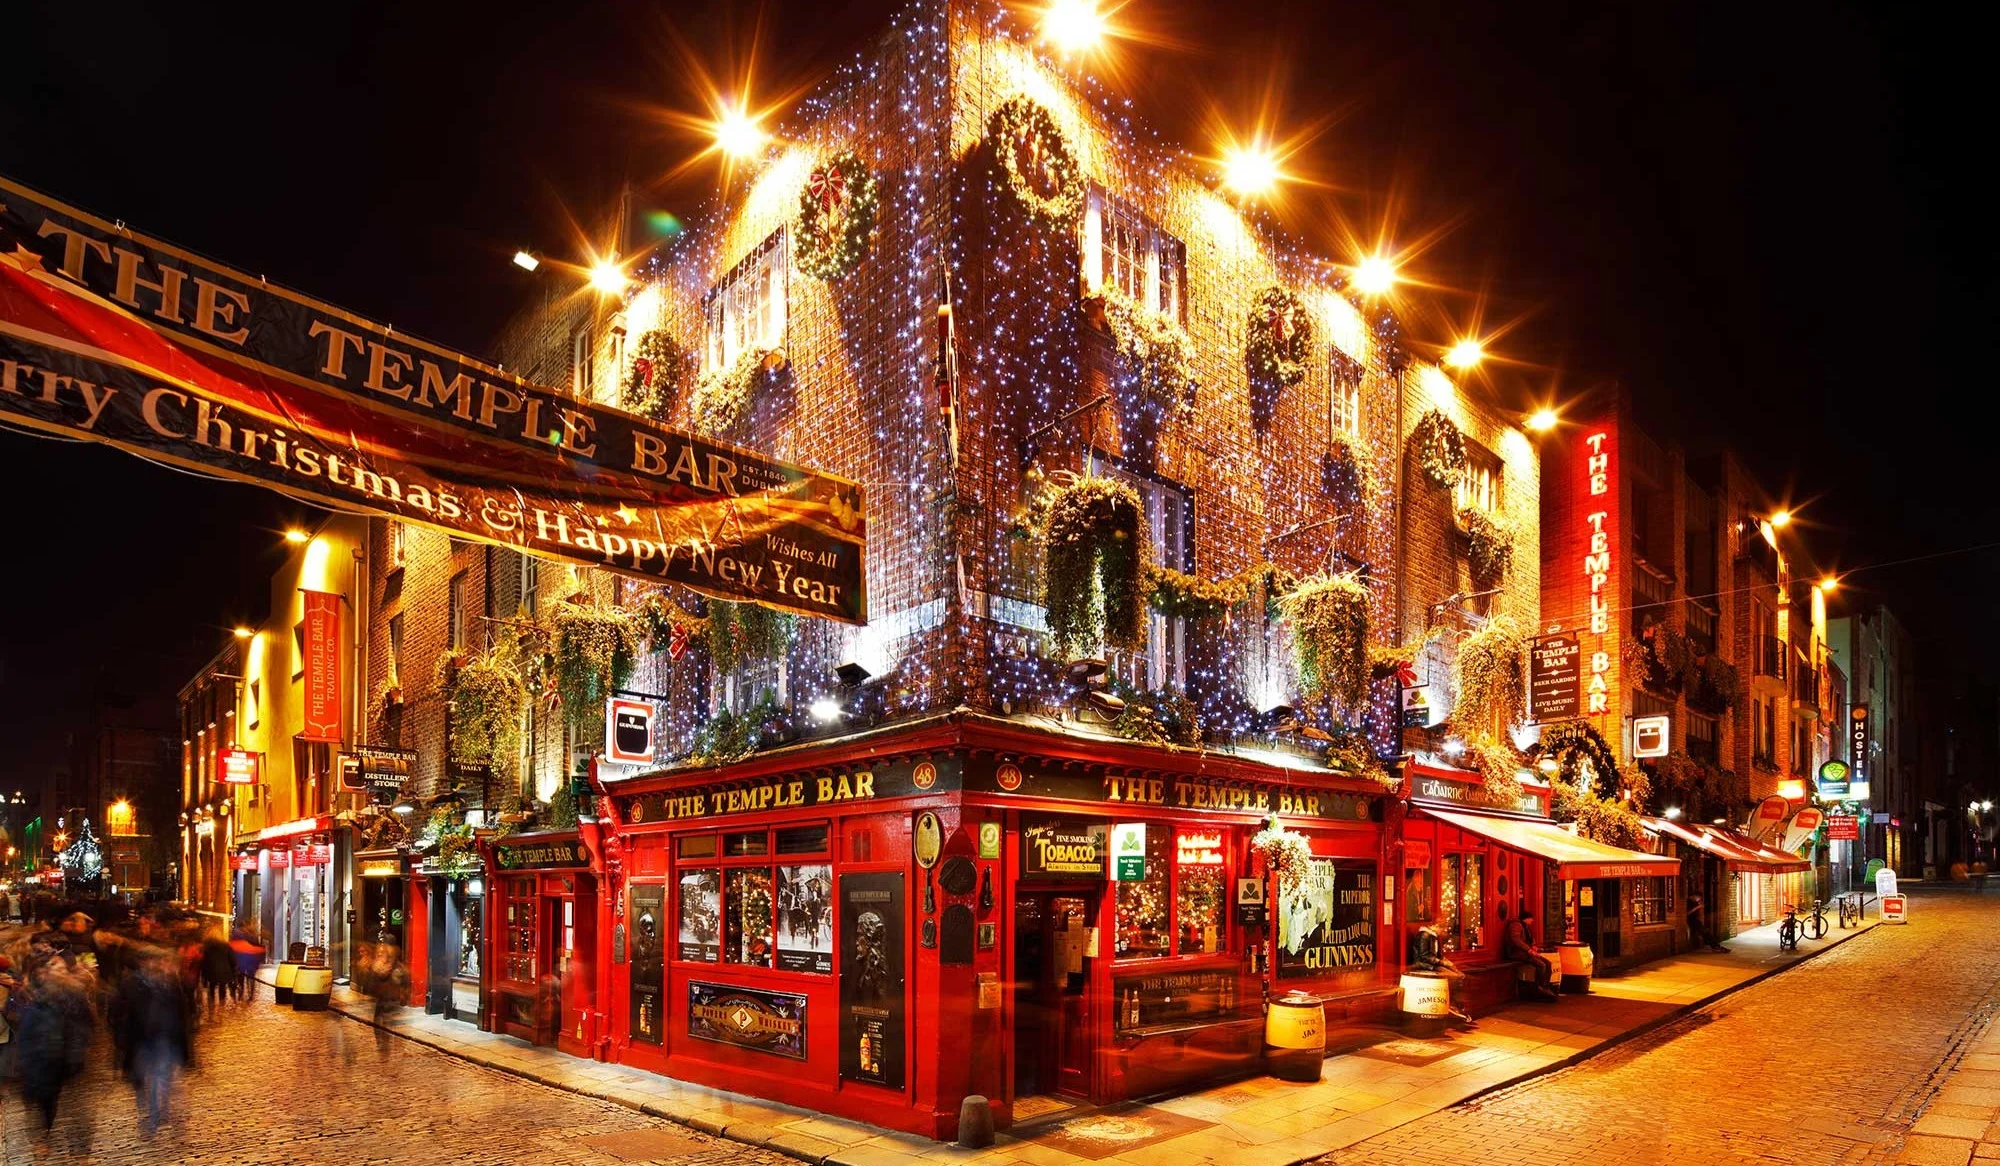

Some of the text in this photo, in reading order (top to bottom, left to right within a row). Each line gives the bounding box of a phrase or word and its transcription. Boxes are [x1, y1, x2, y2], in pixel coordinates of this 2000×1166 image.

[37, 218, 740, 498] THE TEMPLE BAR
[742, 475, 790, 493] DUBLIN
[141, 387, 463, 519] Christmas
[481, 497, 521, 532] &
[531, 507, 679, 576] Happy
[679, 537, 763, 588] New
[772, 559, 841, 606] Year
[766, 533, 838, 569] Wishes All
[1585, 431, 1611, 716] THE TEMPLE BAR
[1547, 640, 1564, 648] THE
[1533, 645, 1579, 659] TEMPLE
[312, 618, 324, 717] THE TEMPLE BAR
[326, 636, 335, 702] TRADING CO.
[1543, 657, 1568, 668] BAR
[1533, 675, 1577, 687] BEER GARDEN
[1535, 697, 1575, 708] LIVE MUSIC
[1544, 705, 1566, 713] DAILY
[358, 750, 417, 761] THE TEMPLE BAR
[1855, 722, 1865, 779] HOSTEL
[365, 772, 410, 782] DISTILLERY
[374, 779, 400, 788] STORE
[664, 795, 705, 819] THE
[712, 781, 805, 813] TEMPLE
[816, 771, 875, 803] BAR
[915, 767, 933, 785] 48
[1001, 768, 1018, 784] 48
[1104, 775, 1164, 804] THE
[1174, 781, 1270, 811] TEMPLE
[1278, 792, 1320, 816] BAR
[1056, 835, 1096, 844] FINE SMOKING
[523, 848, 553, 863] TEMPLE
[554, 847, 573, 861] BAR
[1034, 838, 1096, 868] TOBACCO
[1600, 866, 1610, 876] THE
[1611, 866, 1631, 876] TEMPLE
[1357, 874, 1370, 888] THE
[1341, 890, 1371, 904] EMPEROR
[1362, 907, 1370, 920] OF
[1321, 928, 1347, 943] MALTED
[1304, 944, 1374, 969] GUINNESS
[758, 1016, 792, 1032] WHISKEY
